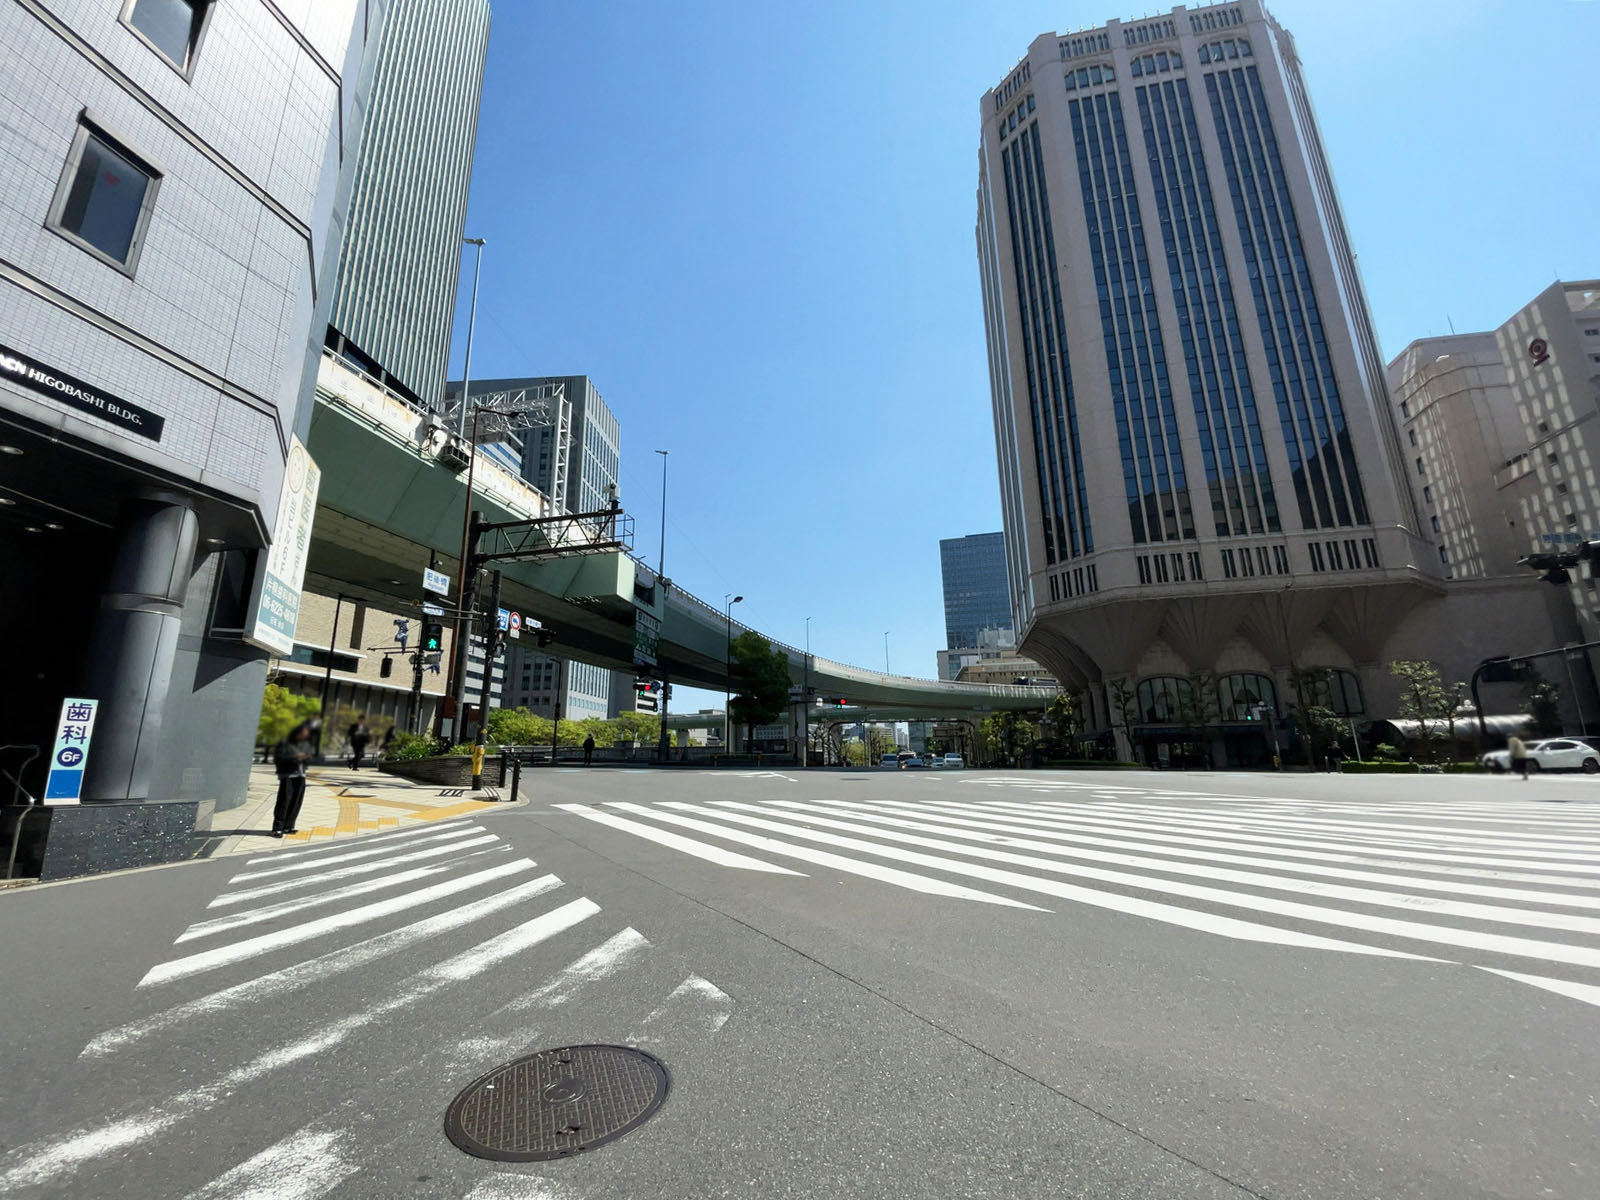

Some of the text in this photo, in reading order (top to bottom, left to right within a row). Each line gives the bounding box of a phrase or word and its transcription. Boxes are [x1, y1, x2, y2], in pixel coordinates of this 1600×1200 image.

[28, 368, 105, 409] HIGOBASHI
[107, 403, 143, 426] BLDG.
[61, 703, 93, 745] 歯科
[61, 751, 80, 763] 6F
